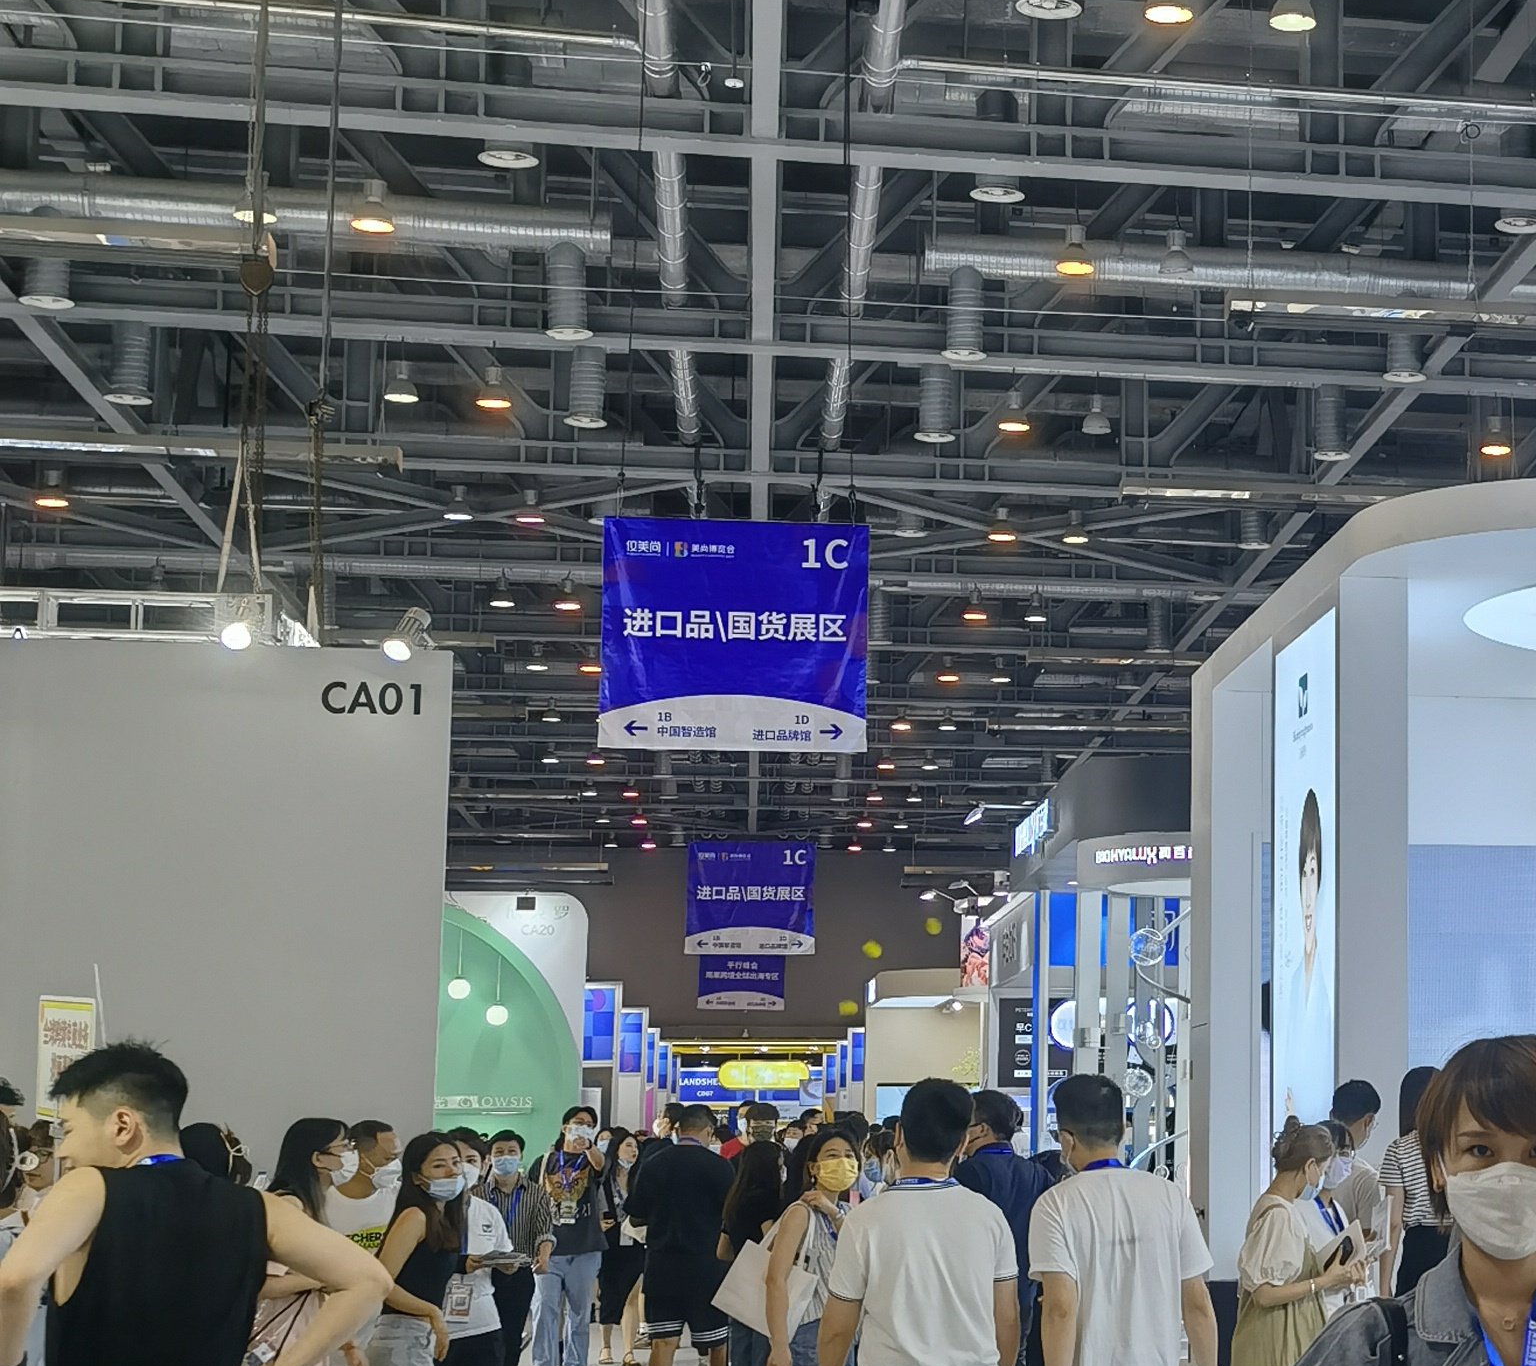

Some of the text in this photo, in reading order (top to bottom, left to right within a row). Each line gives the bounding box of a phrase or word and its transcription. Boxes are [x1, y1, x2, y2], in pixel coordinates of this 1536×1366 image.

[801, 538, 849, 569] 1C
[623, 607, 847, 642] 进口品\国货展区
[321, 681, 424, 716] CA01
[657, 712, 672, 723] 1B
[795, 715, 810, 726] 1D
[751, 728, 812, 743] 进口品牌馆
[783, 849, 807, 866] 1C
[696, 885, 806, 902] 进口品\国货展区
